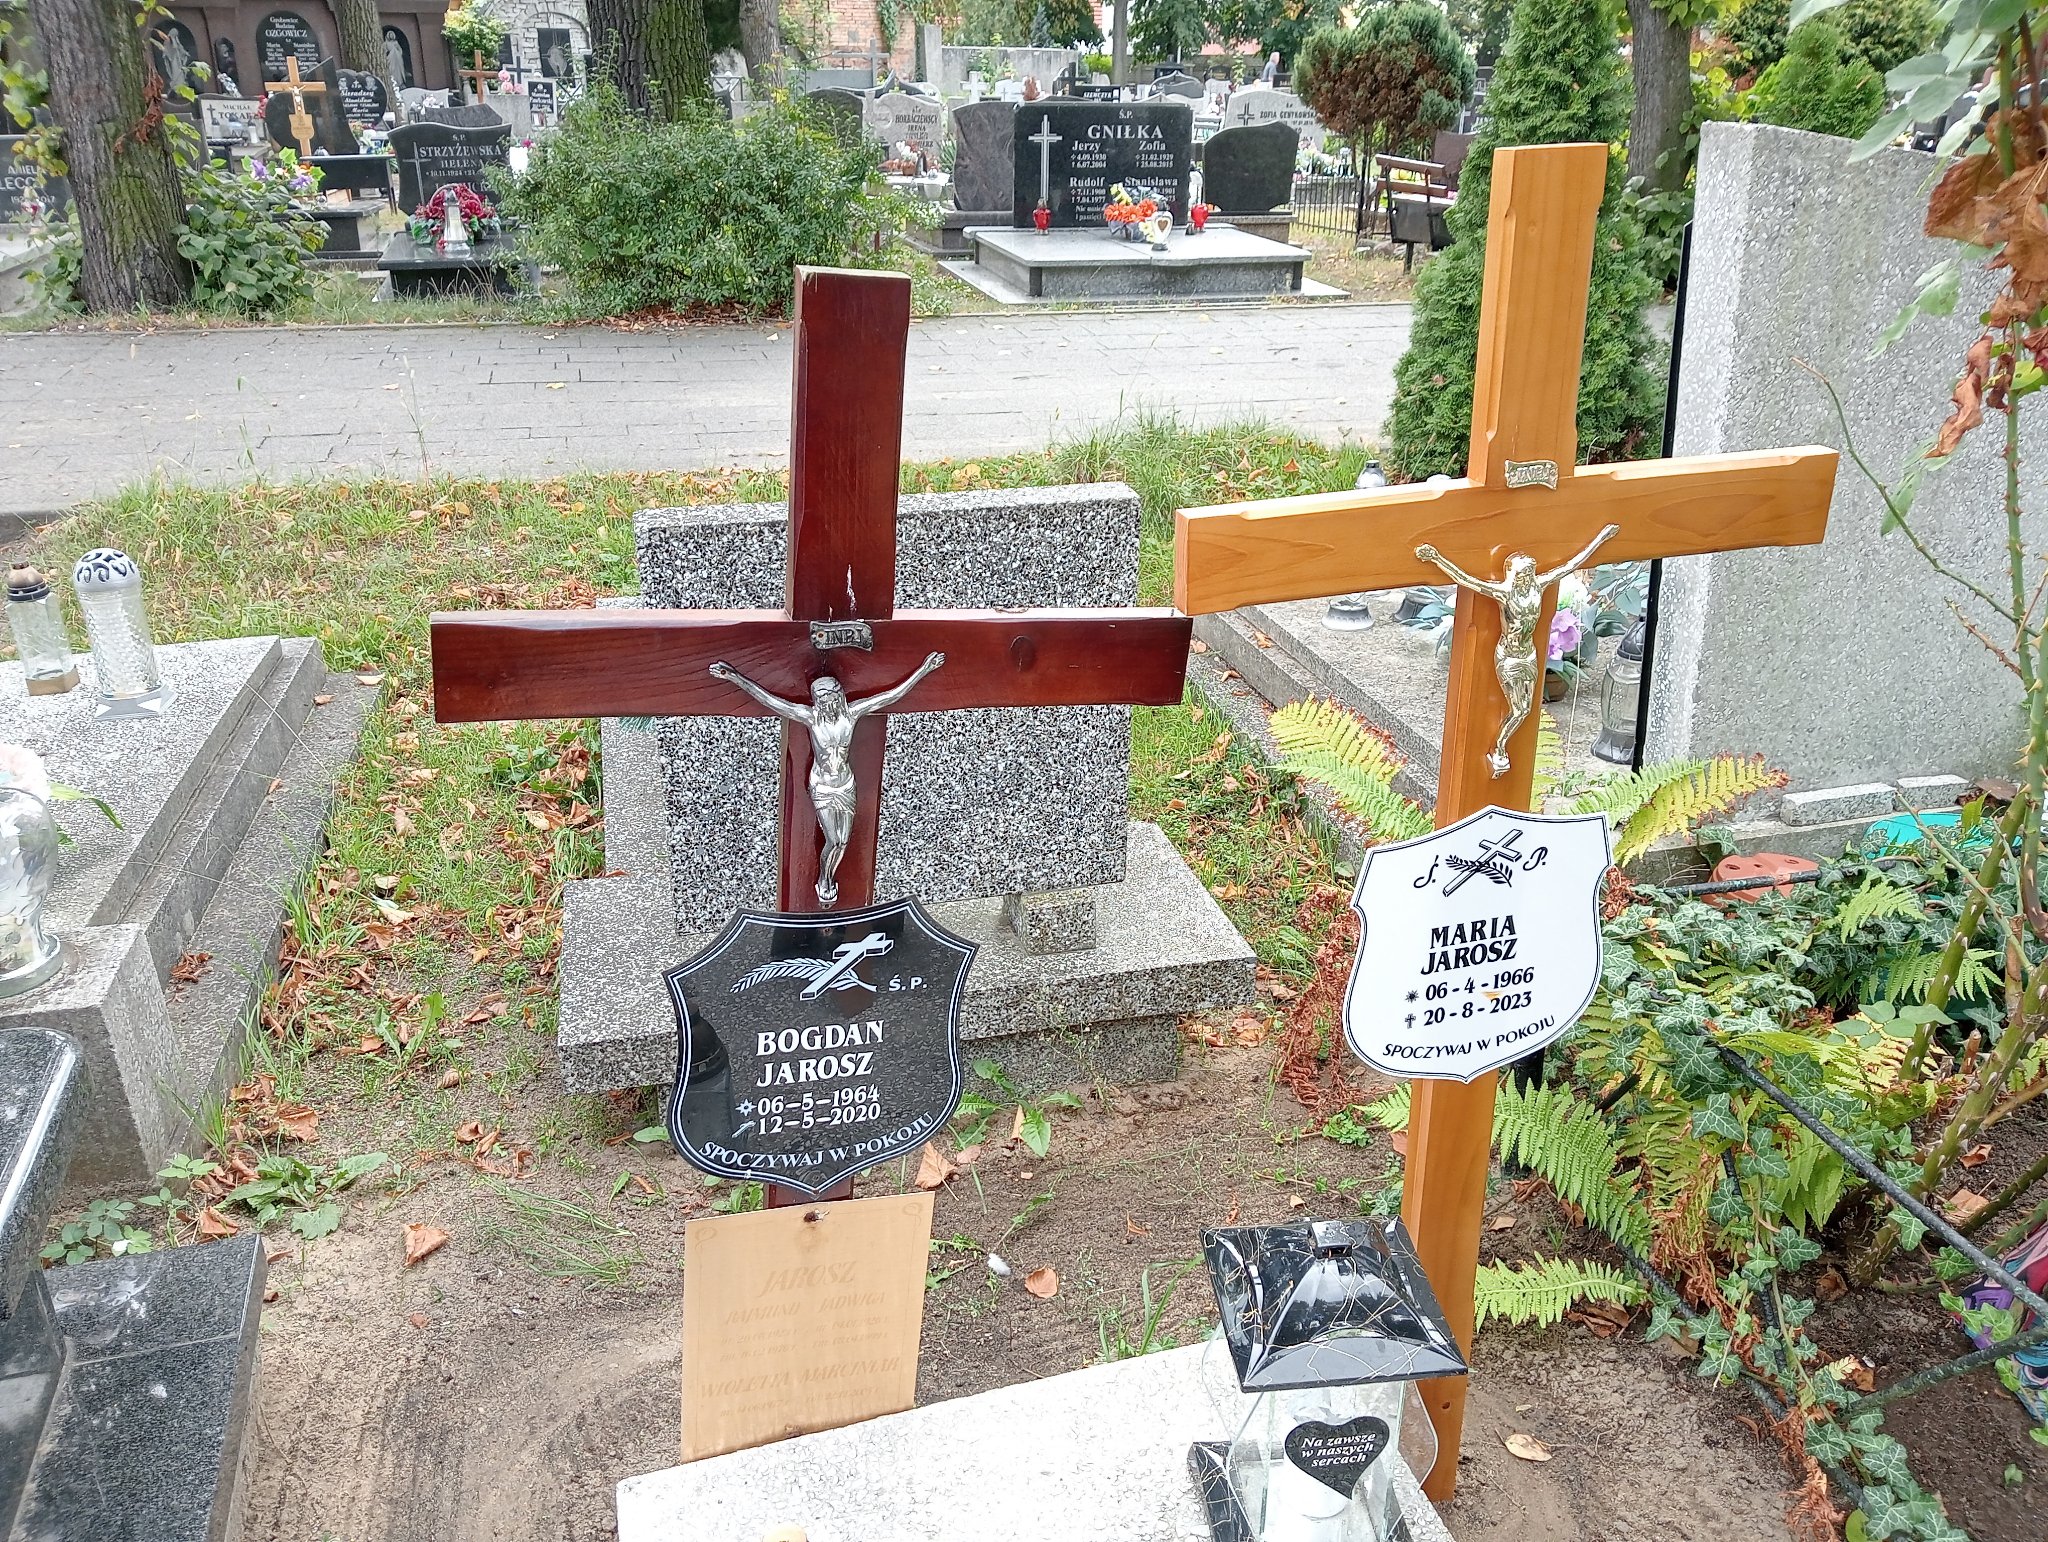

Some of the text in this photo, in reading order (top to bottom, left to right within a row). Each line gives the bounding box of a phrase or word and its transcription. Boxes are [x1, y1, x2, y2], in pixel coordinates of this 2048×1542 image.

[1087, 124, 1164, 139] GNIŁKA
[419, 143, 502, 158] STRZYŻEWSKA
[1072, 140, 1166, 153] Jerzy Zofia
[1070, 176, 1105, 187] Rudolf
[1429, 914, 1517, 950] MARIA
[1420, 938, 1518, 975] JAROSZ
[755, 1019, 885, 1056] BOGDAN
[1382, 1014, 1556, 1059] SPOCZYWAJ W POKOJU
[756, 1051, 875, 1088] JAROSZ
[699, 1112, 934, 1168] SPOCZYWAJ W POKOJU
[758, 1260, 857, 1298] JAROSZ
[1301, 1433, 1376, 1448] Na zawsze
[1301, 1443, 1374, 1458] w naszych
[1311, 1454, 1367, 1467] sercach
